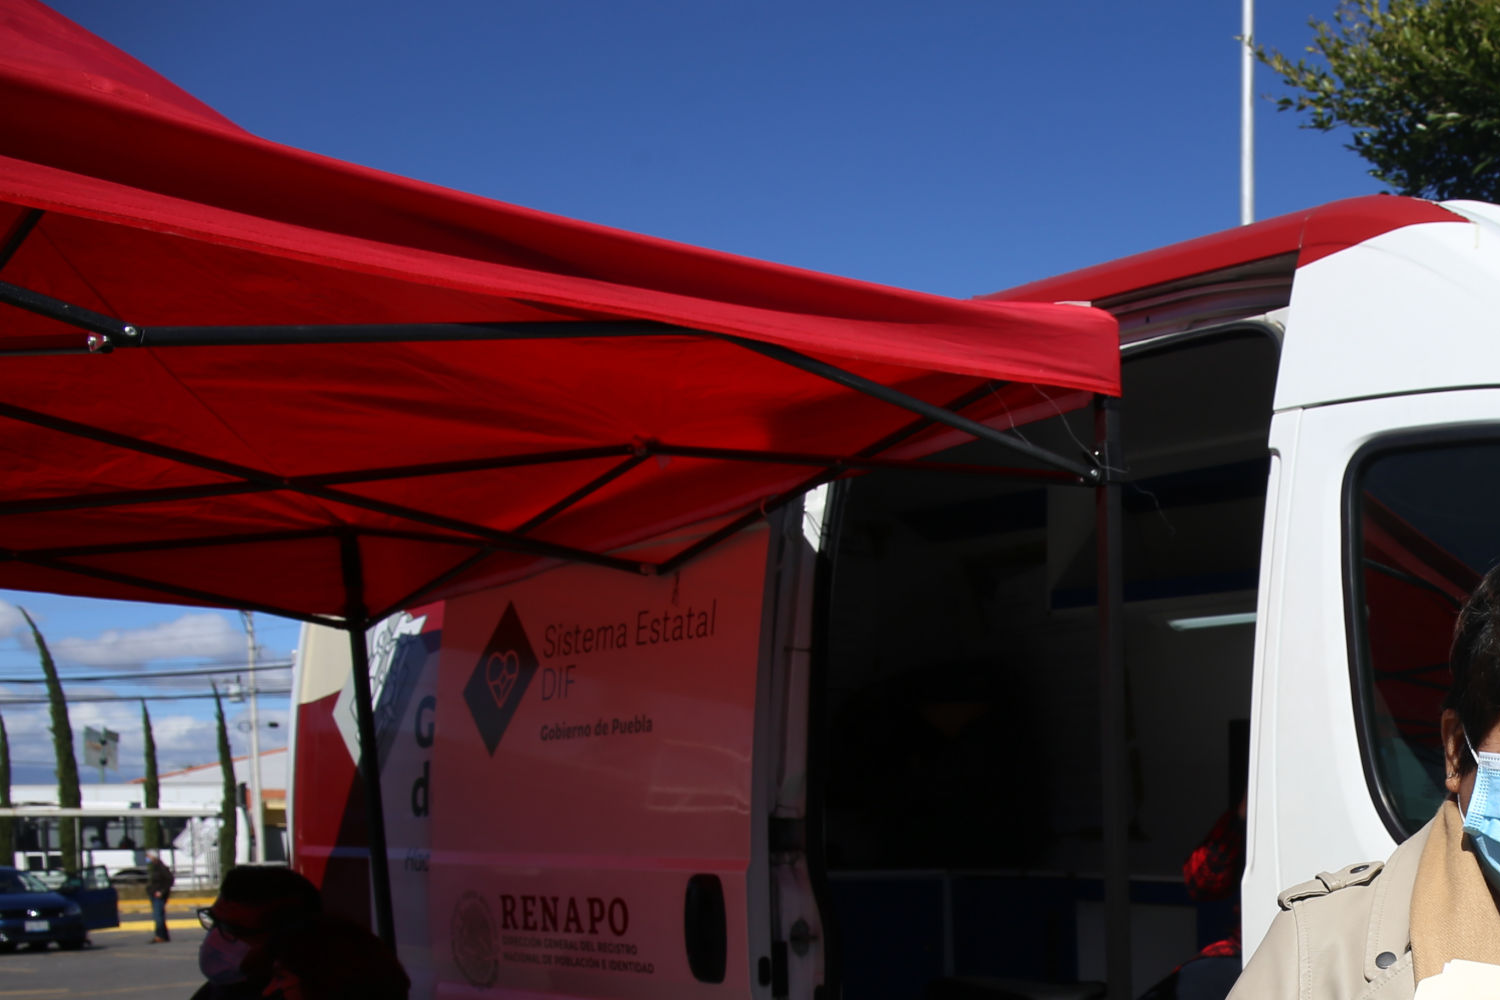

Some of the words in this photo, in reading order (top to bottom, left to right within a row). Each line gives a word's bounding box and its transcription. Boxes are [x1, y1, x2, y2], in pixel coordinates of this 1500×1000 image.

[543, 621, 628, 659] Sistema
[636, 598, 717, 646] Estatal
[542, 665, 576, 701] DIF
[540, 721, 592, 742] Gobierno
[594, 719, 609, 736] de
[612, 714, 654, 735] Puebla
[500, 895, 629, 937] RENAPO
